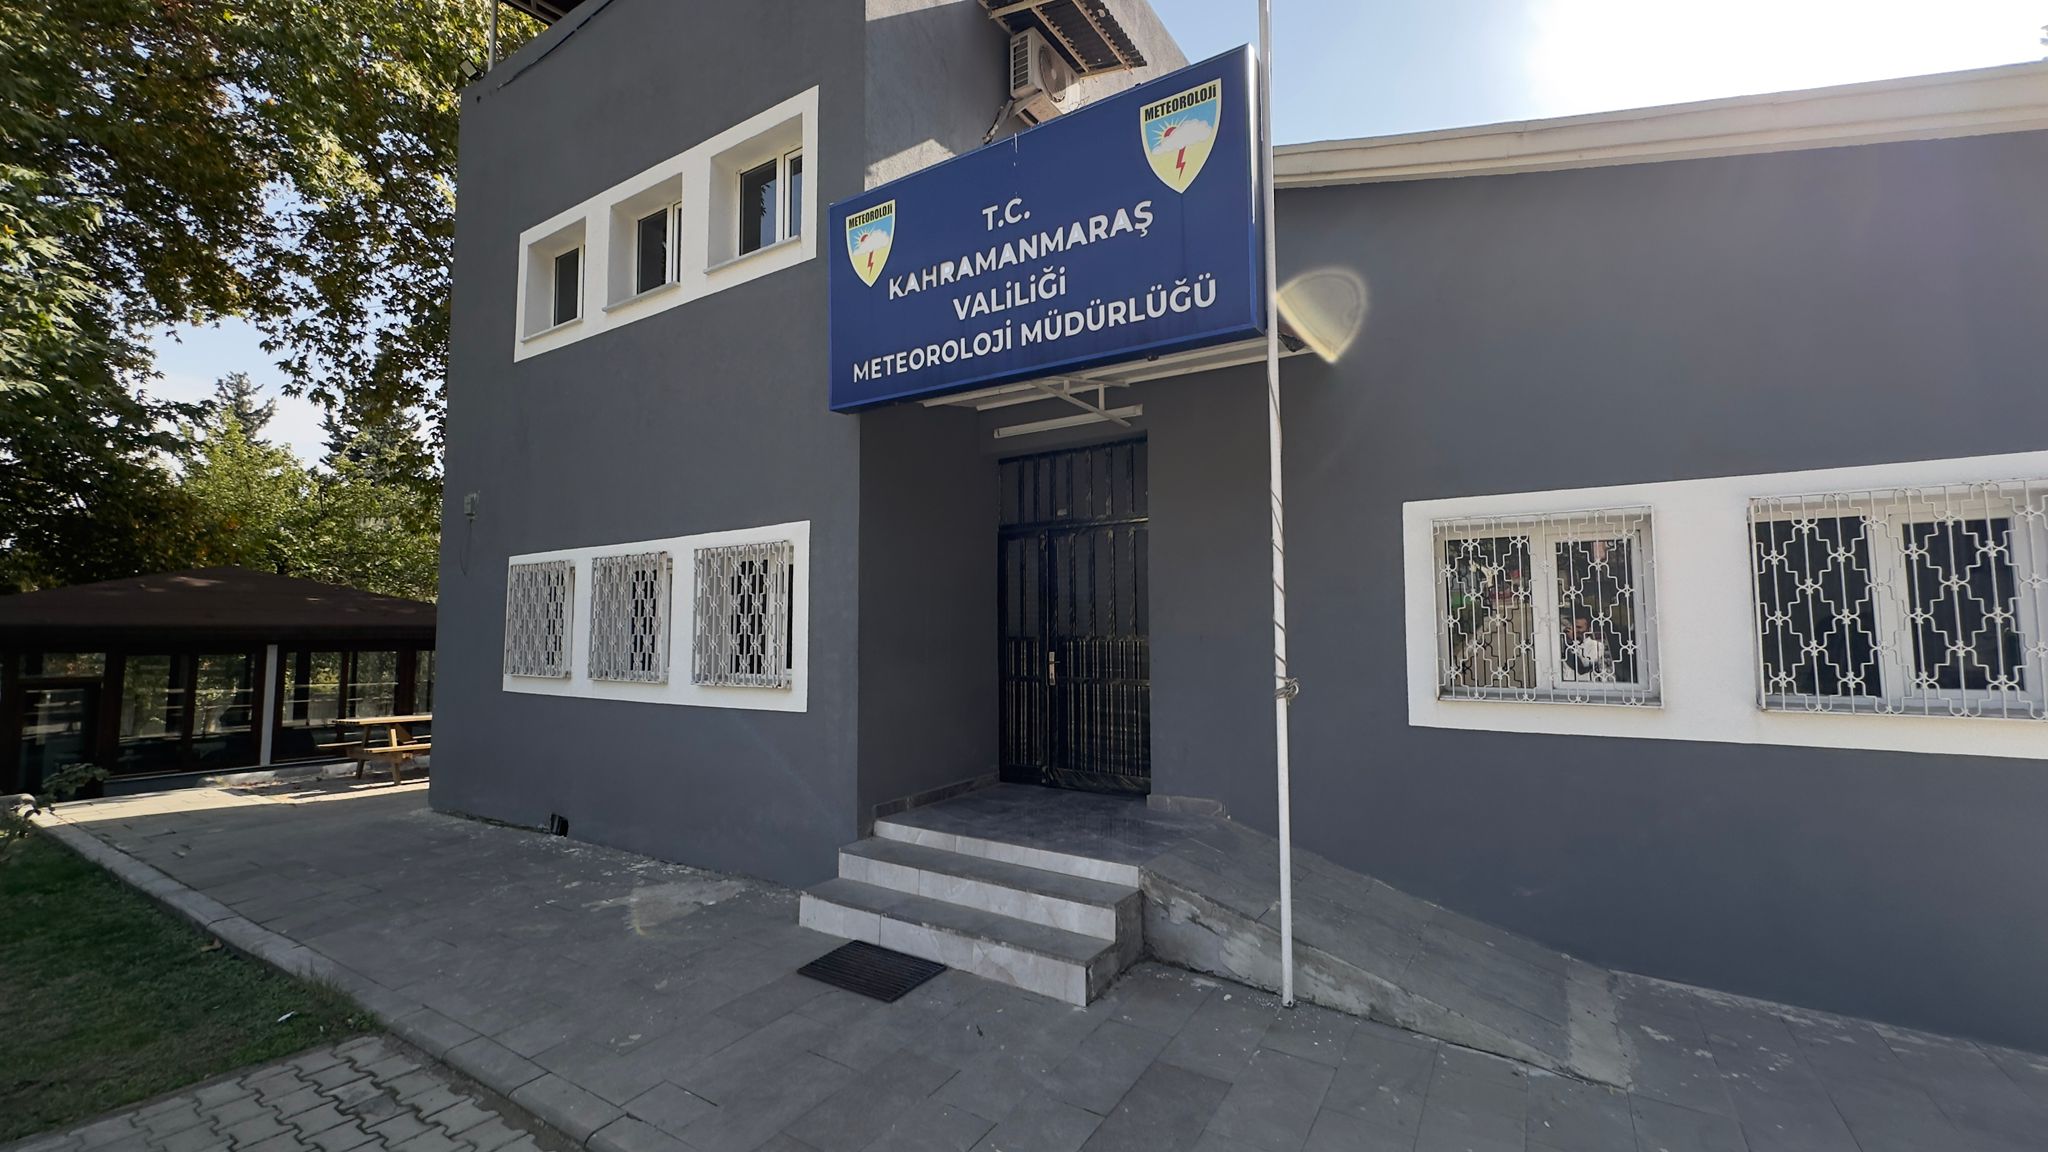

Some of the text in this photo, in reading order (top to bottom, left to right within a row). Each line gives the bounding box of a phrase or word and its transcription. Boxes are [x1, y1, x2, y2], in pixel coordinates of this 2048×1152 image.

[889, 200, 1154, 300] KAHRAMANMARAŞ
[982, 198, 1031, 231] T.C.
[853, 272, 1216, 383] METEOROLOJİ MÜDÜRLÜĞÜ
